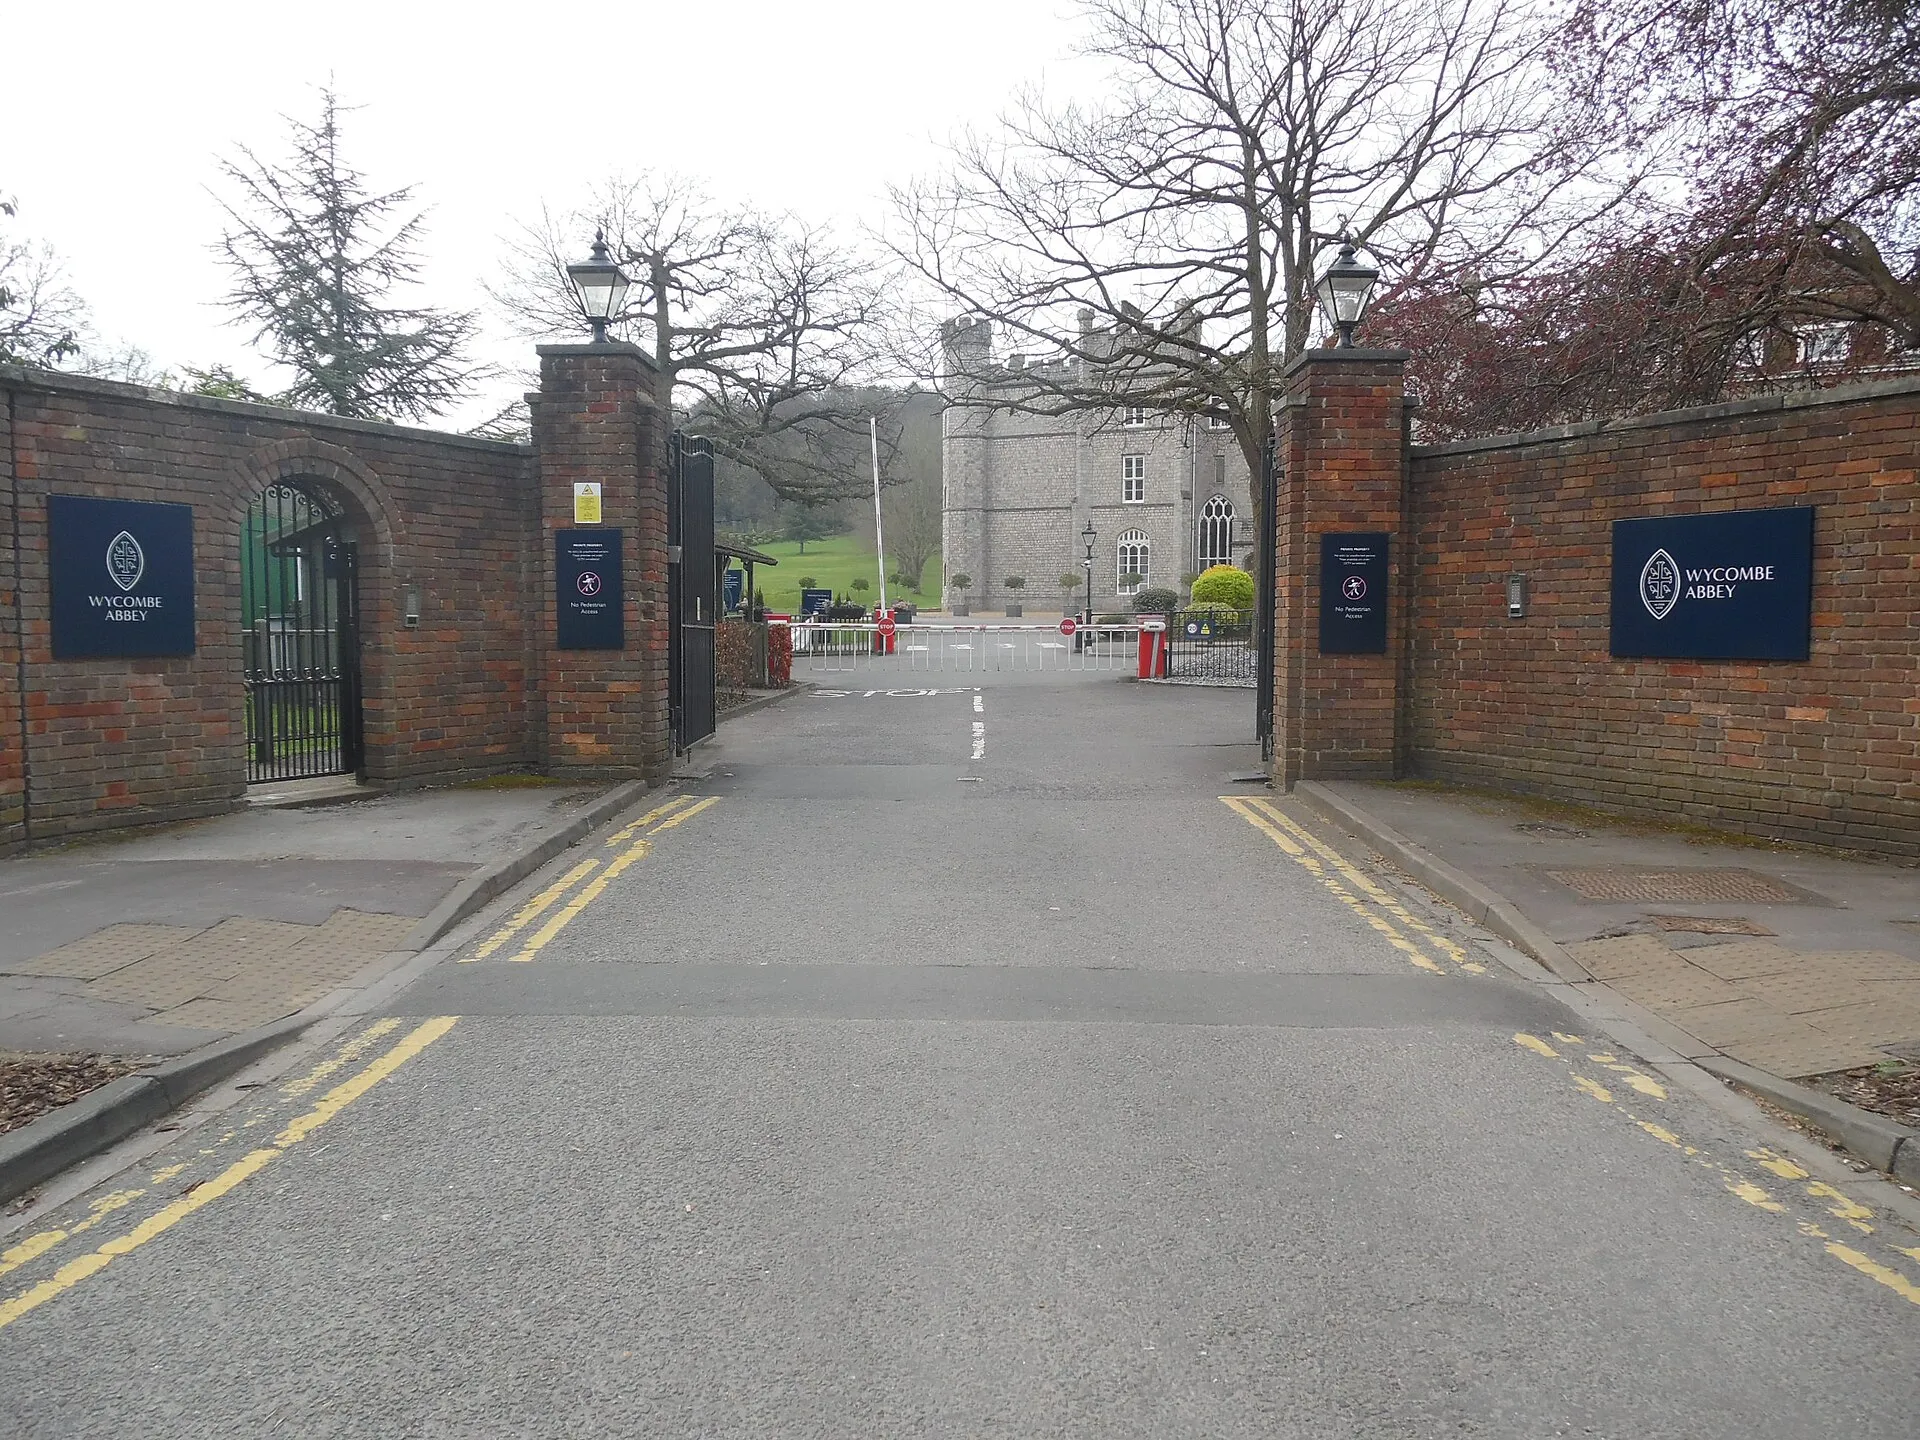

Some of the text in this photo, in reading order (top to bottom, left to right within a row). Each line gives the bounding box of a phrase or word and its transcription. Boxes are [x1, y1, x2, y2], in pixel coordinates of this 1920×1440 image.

[1685, 566, 1775, 582] WYCOMBE
[1685, 585, 1736, 599] ABBEY
[88, 596, 163, 608] WYCOMBE
[105, 610, 148, 621] ABBEY
[808, 688, 971, 698] STOP
